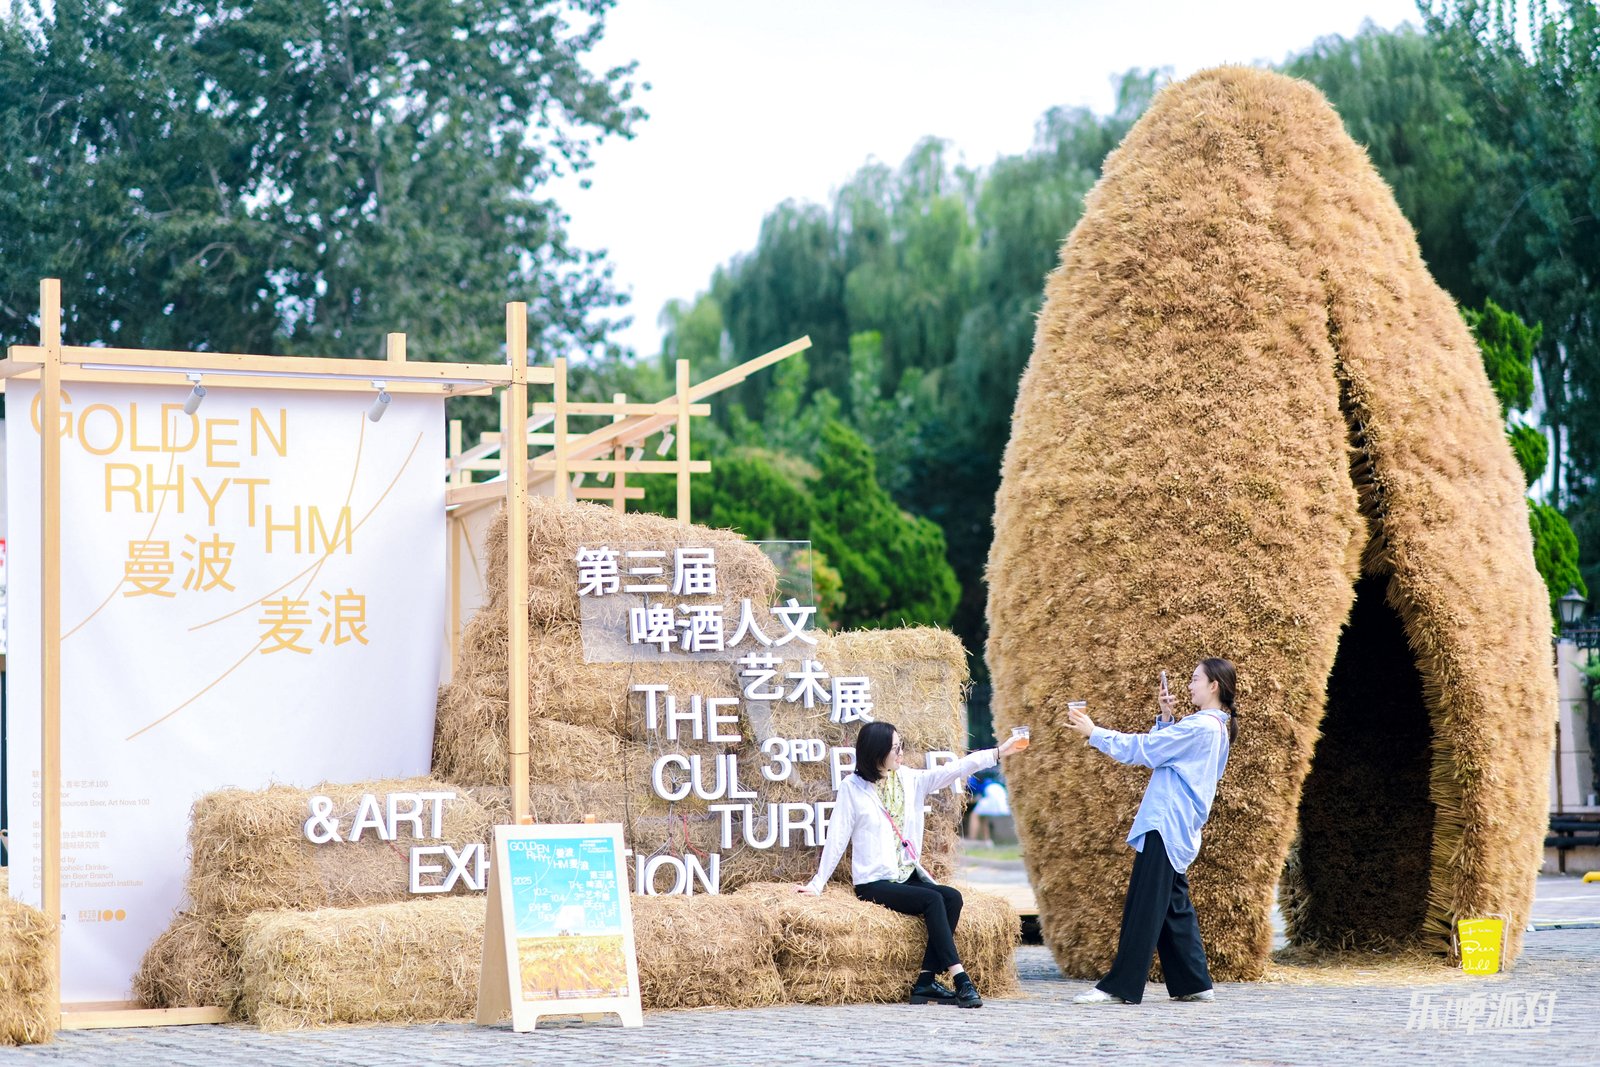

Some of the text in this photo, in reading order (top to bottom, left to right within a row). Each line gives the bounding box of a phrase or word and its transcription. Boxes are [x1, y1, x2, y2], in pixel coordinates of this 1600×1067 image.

[30, 387, 288, 468] GOLDEN
[104, 462, 353, 555] RHYTHM
[123, 532, 236, 598] 曼波
[575, 546, 717, 597] 第三届
[258, 587, 369, 655] 麦浪
[629, 598, 818, 654] 啤酒人文
[631, 684, 742, 743] THE
[739, 652, 875, 725] 艺术展
[651, 753, 758, 801] CUL
[759, 736, 826, 782] 3RD
[304, 791, 457, 844] & ART
[509, 841, 550, 854] GOLDEN
[513, 876, 533, 886] 2025
